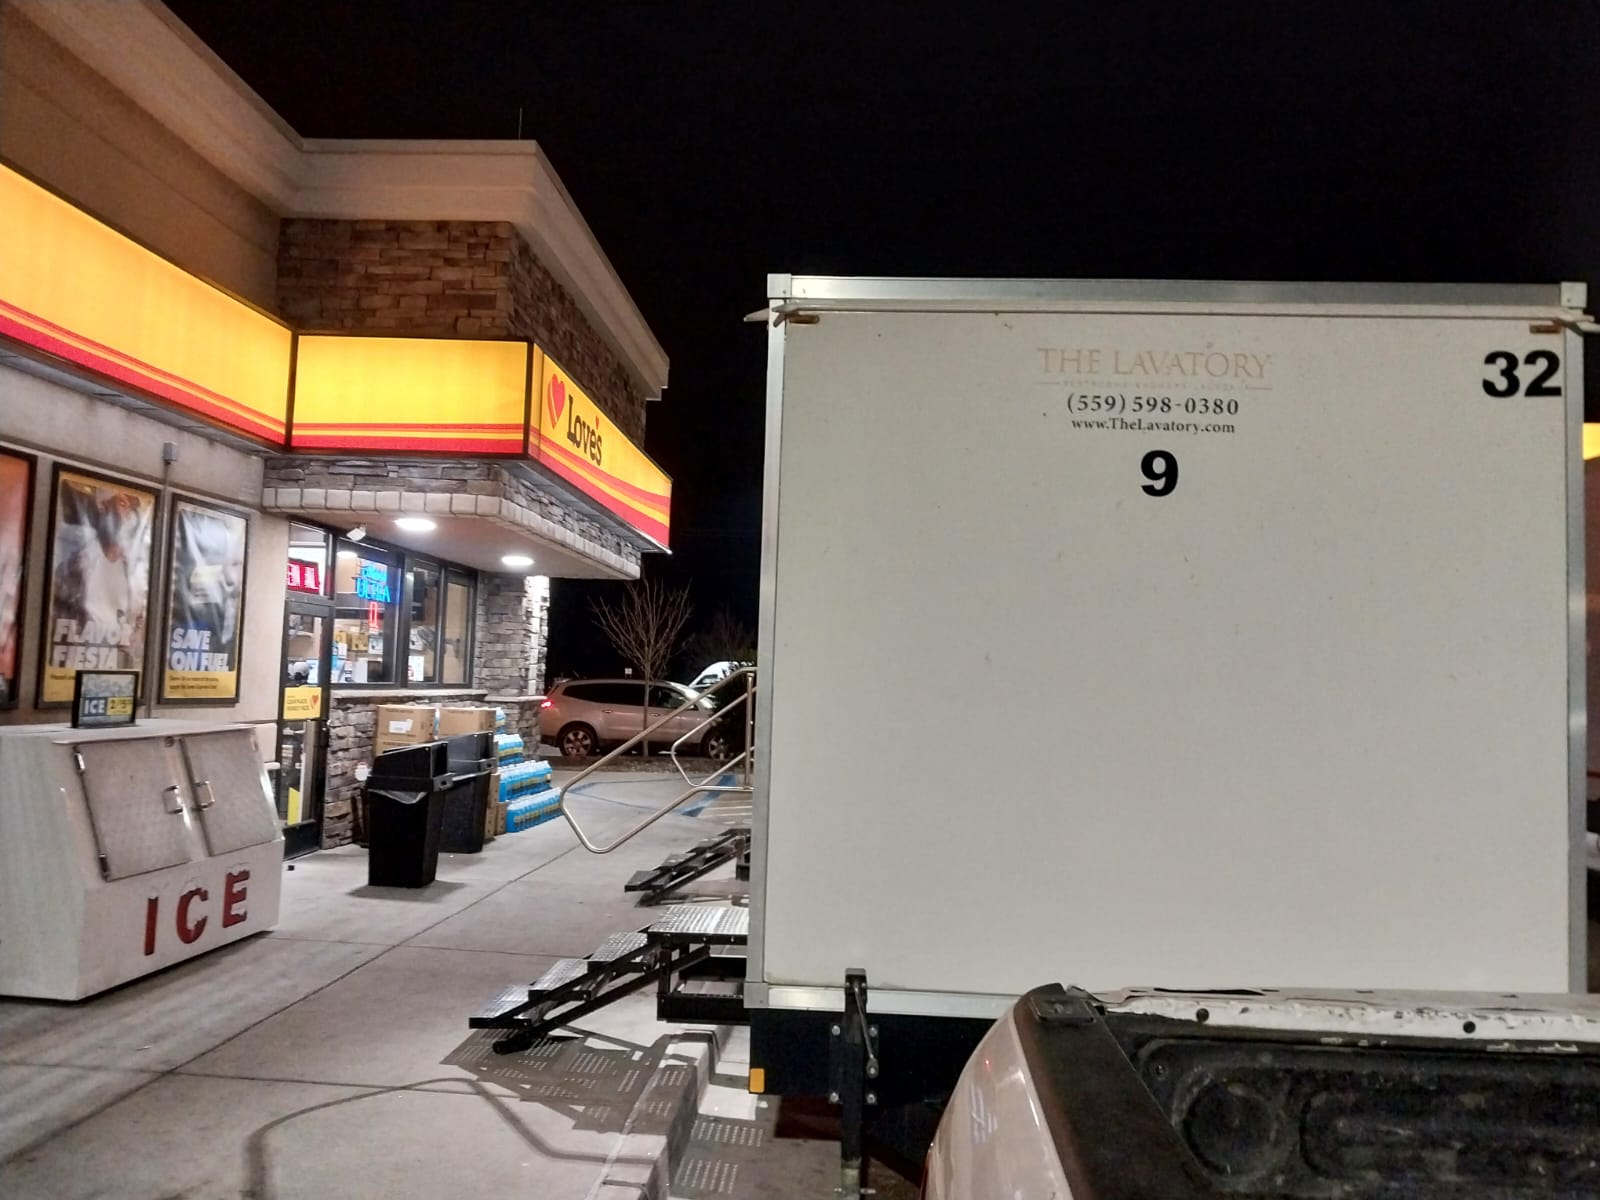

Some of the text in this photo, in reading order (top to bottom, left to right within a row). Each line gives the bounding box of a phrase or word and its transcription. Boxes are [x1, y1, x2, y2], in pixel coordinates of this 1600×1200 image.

[1037, 347, 1271, 379] THE LAVATORY
[1482, 350, 1562, 398] 32
[1066, 392, 1239, 416] (559) 598-0380
[566, 393, 603, 466] Love's
[1071, 417, 1236, 435] www.TheLavatory.com
[1140, 449, 1179, 497] 9
[171, 628, 212, 651] SAVE
[170, 650, 199, 672] ON
[84, 699, 105, 715] ICE
[144, 868, 251, 956] ICE
